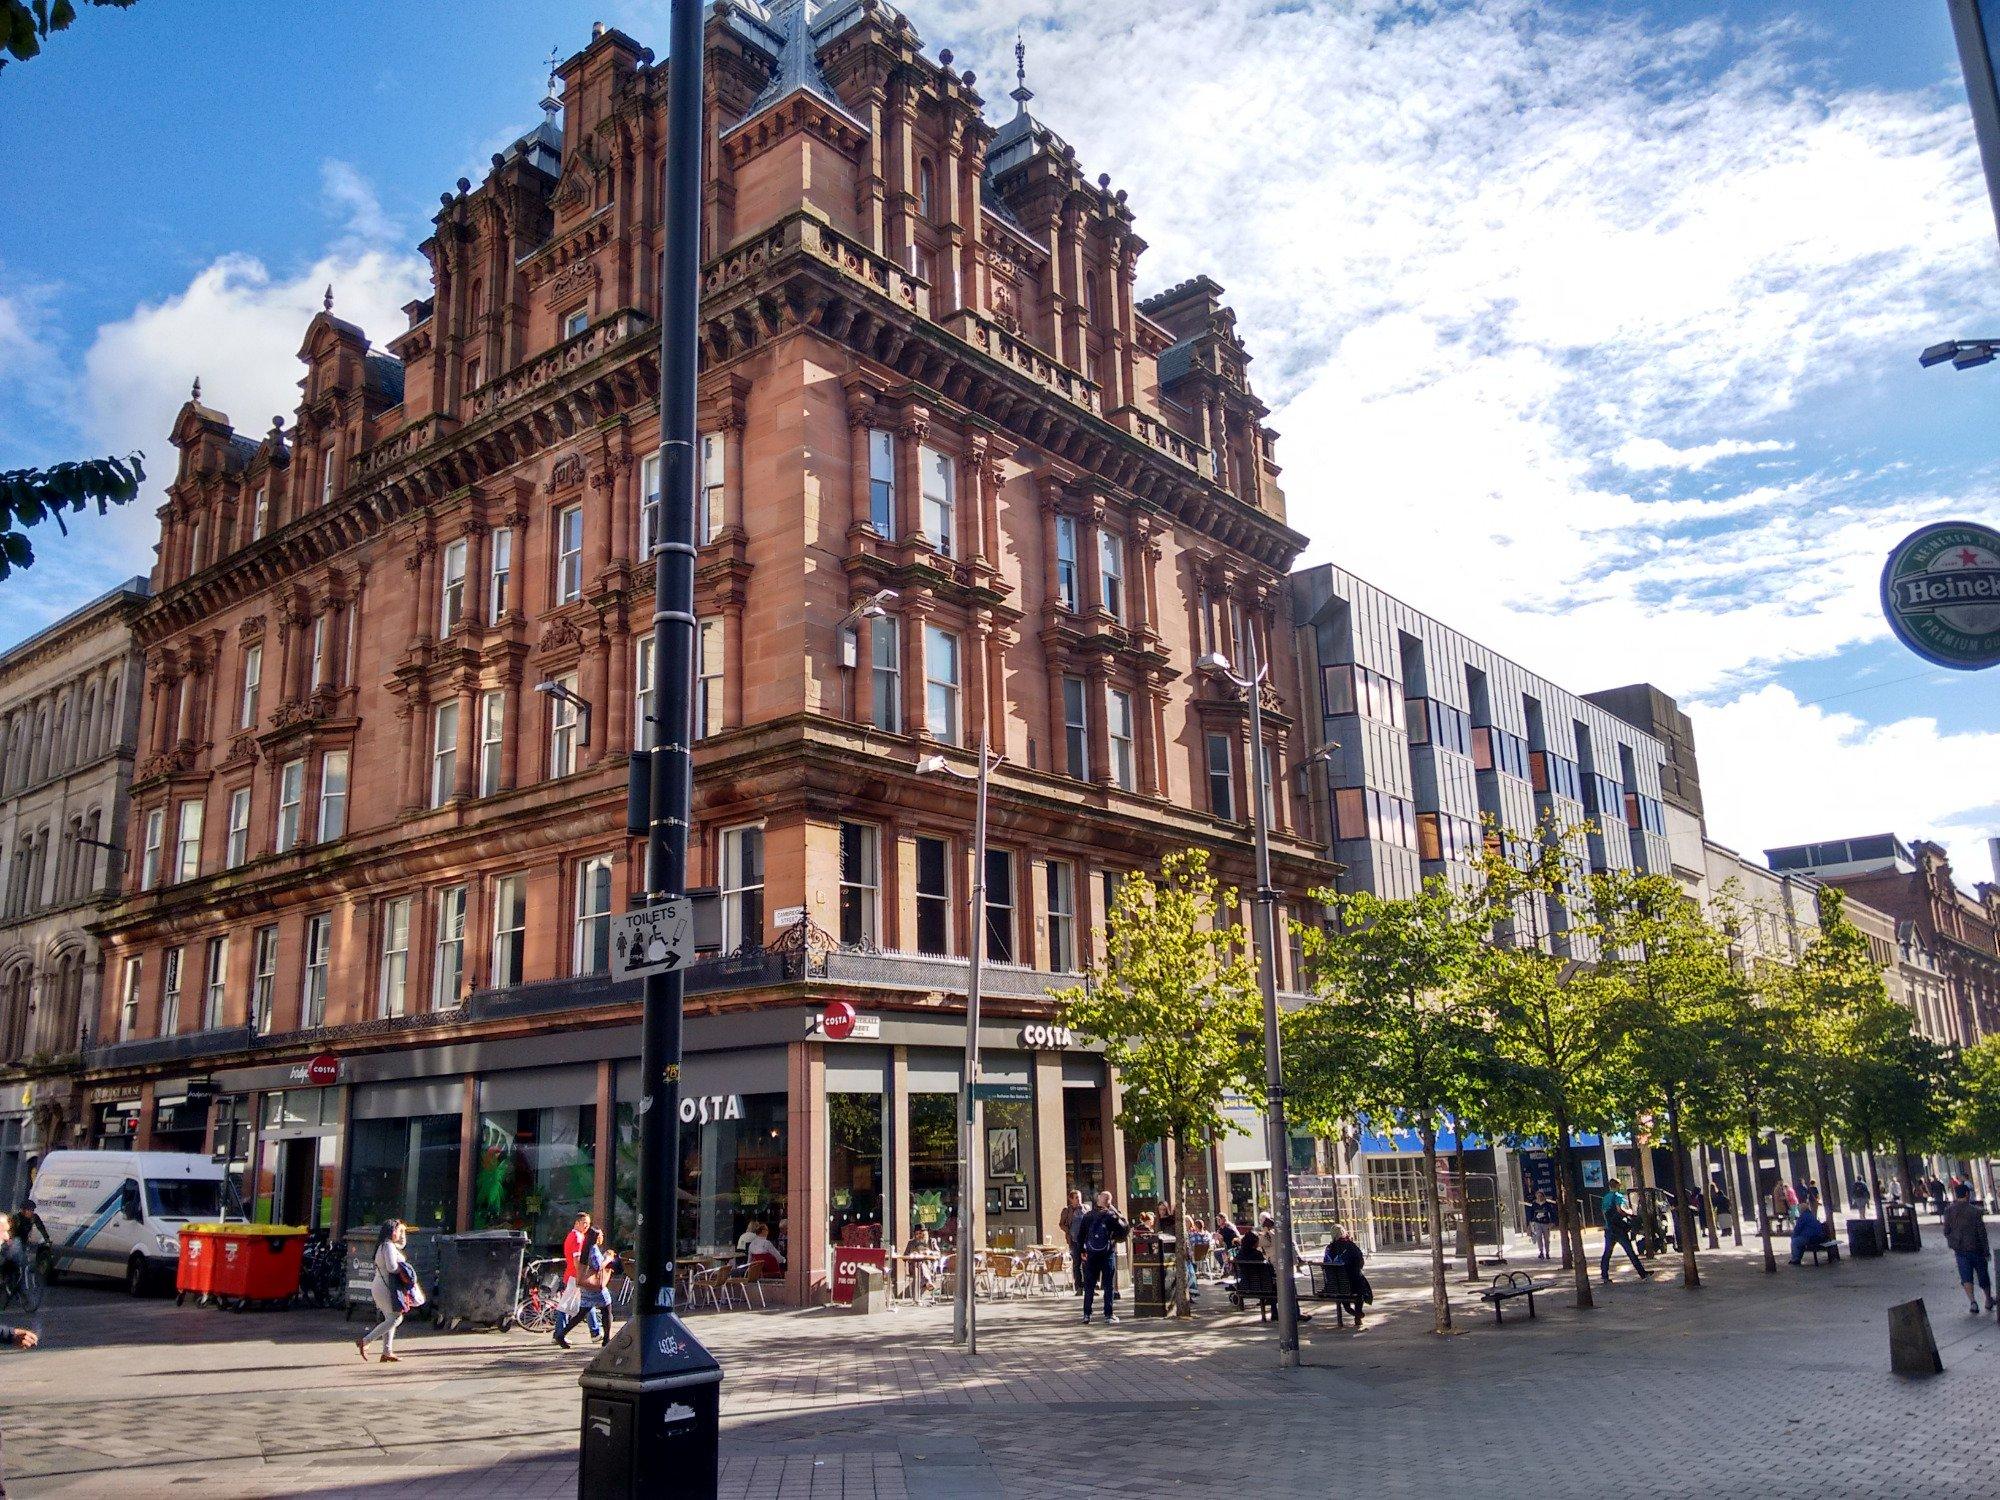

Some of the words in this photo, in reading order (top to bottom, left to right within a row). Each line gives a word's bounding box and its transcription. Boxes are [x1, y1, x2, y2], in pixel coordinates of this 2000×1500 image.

[1913, 534, 1972, 562] HEINEKEN
[1906, 575, 2000, 604] Heinek
[1921, 619, 1979, 651] PREMIUM
[625, 906, 676, 928] TOILETS
[825, 1015, 848, 1026] COSTA
[1024, 1024, 1073, 1048] COSTA
[313, 1066, 335, 1074] COSTA
[680, 1094, 742, 1125] OSTA
